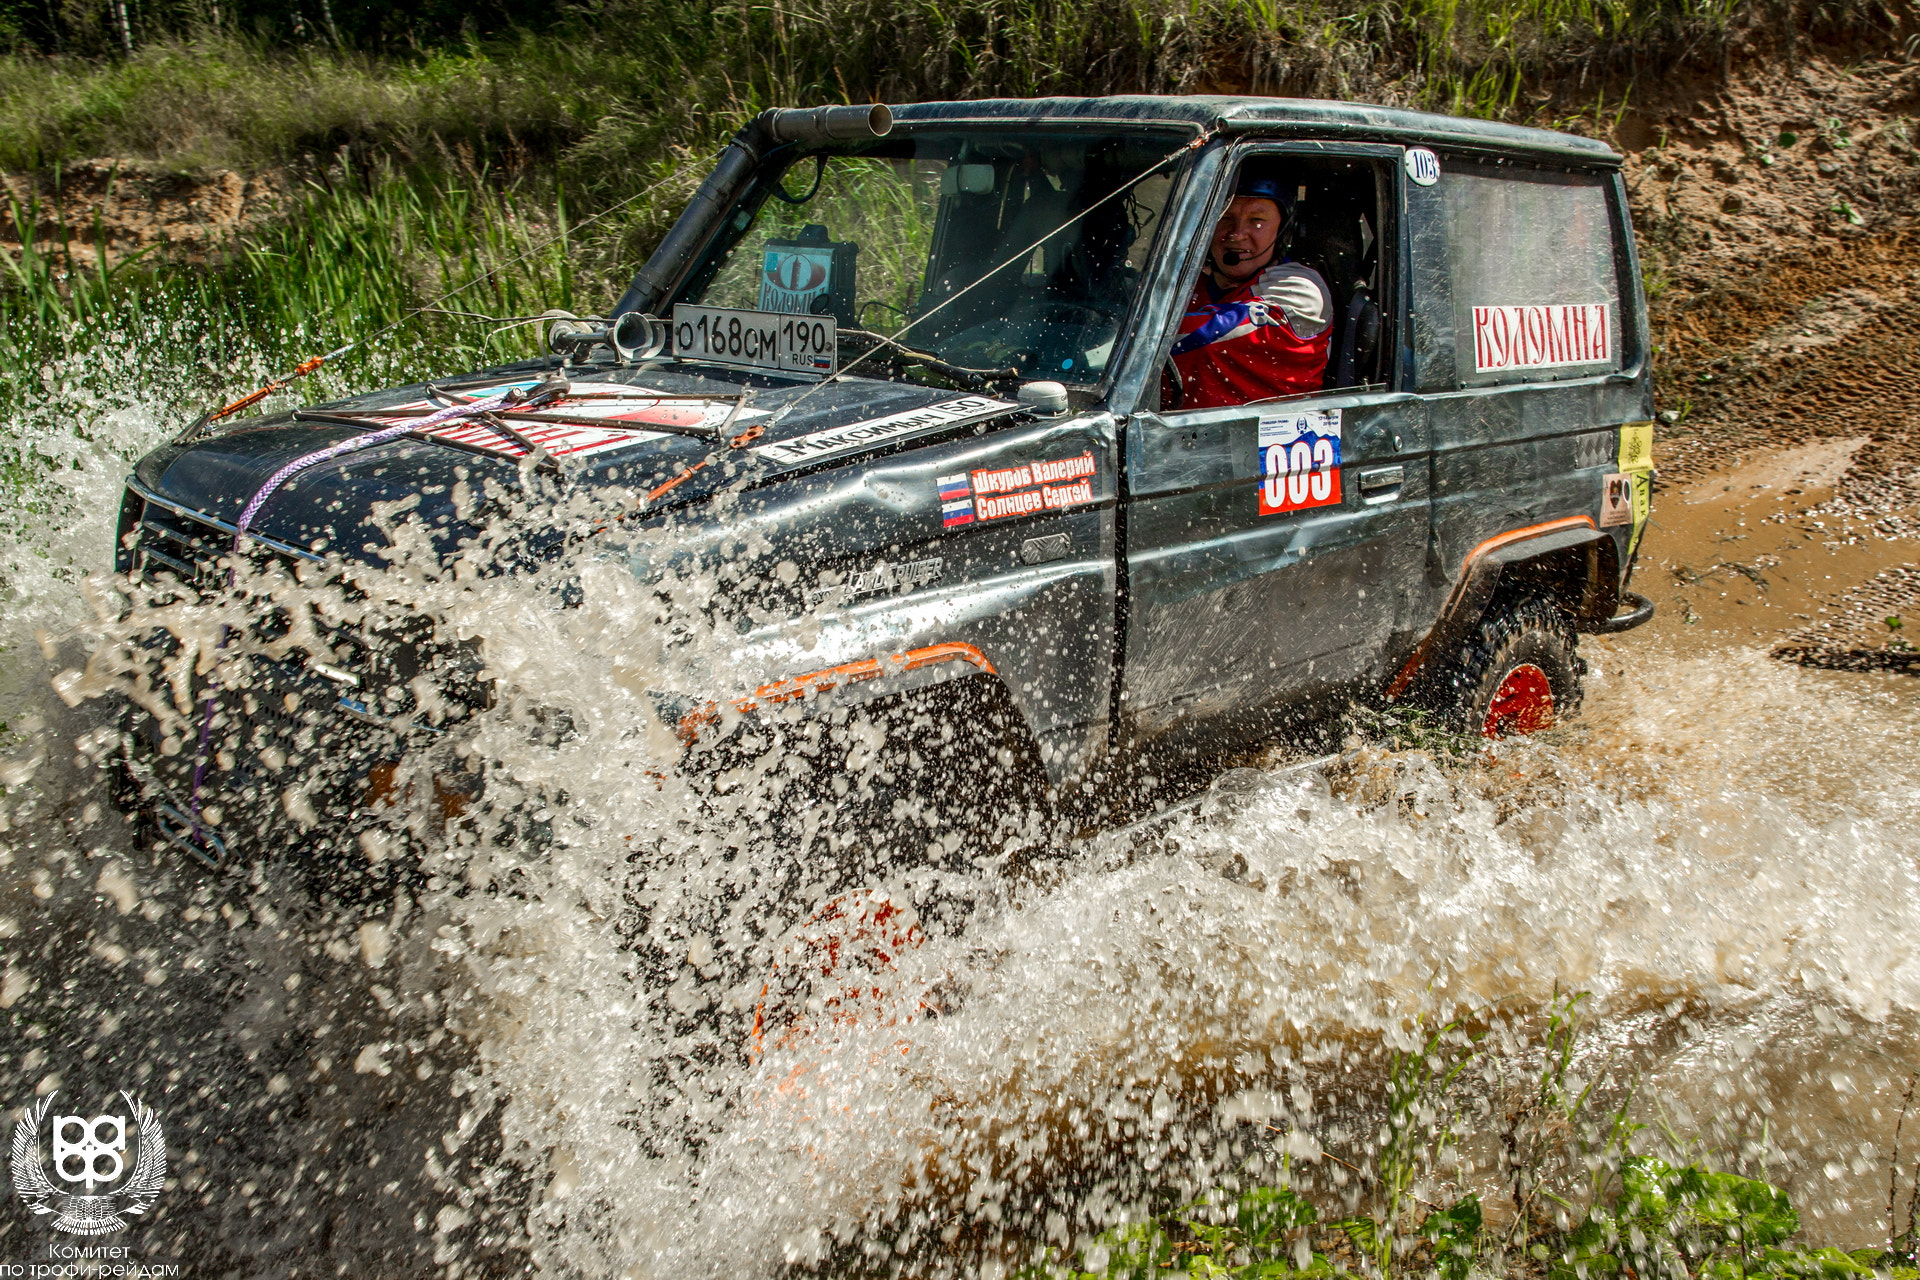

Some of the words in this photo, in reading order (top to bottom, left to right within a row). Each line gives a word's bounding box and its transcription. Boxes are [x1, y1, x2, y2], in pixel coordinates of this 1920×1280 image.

[1413, 151, 1437, 179] 103
[762, 282, 826, 314] КОЛОМН
[783, 320, 826, 353] 190
[1474, 305, 1608, 370] КОЛОМНА
[792, 353, 814, 366] RUS
[938, 399, 985, 413] 50
[972, 469, 1031, 494] Шкуров
[1031, 452, 1096, 484] Валерий
[1265, 438, 1334, 508] 003
[976, 491, 1042, 520] Солнцев
[1043, 479, 1092, 508] Сергей
